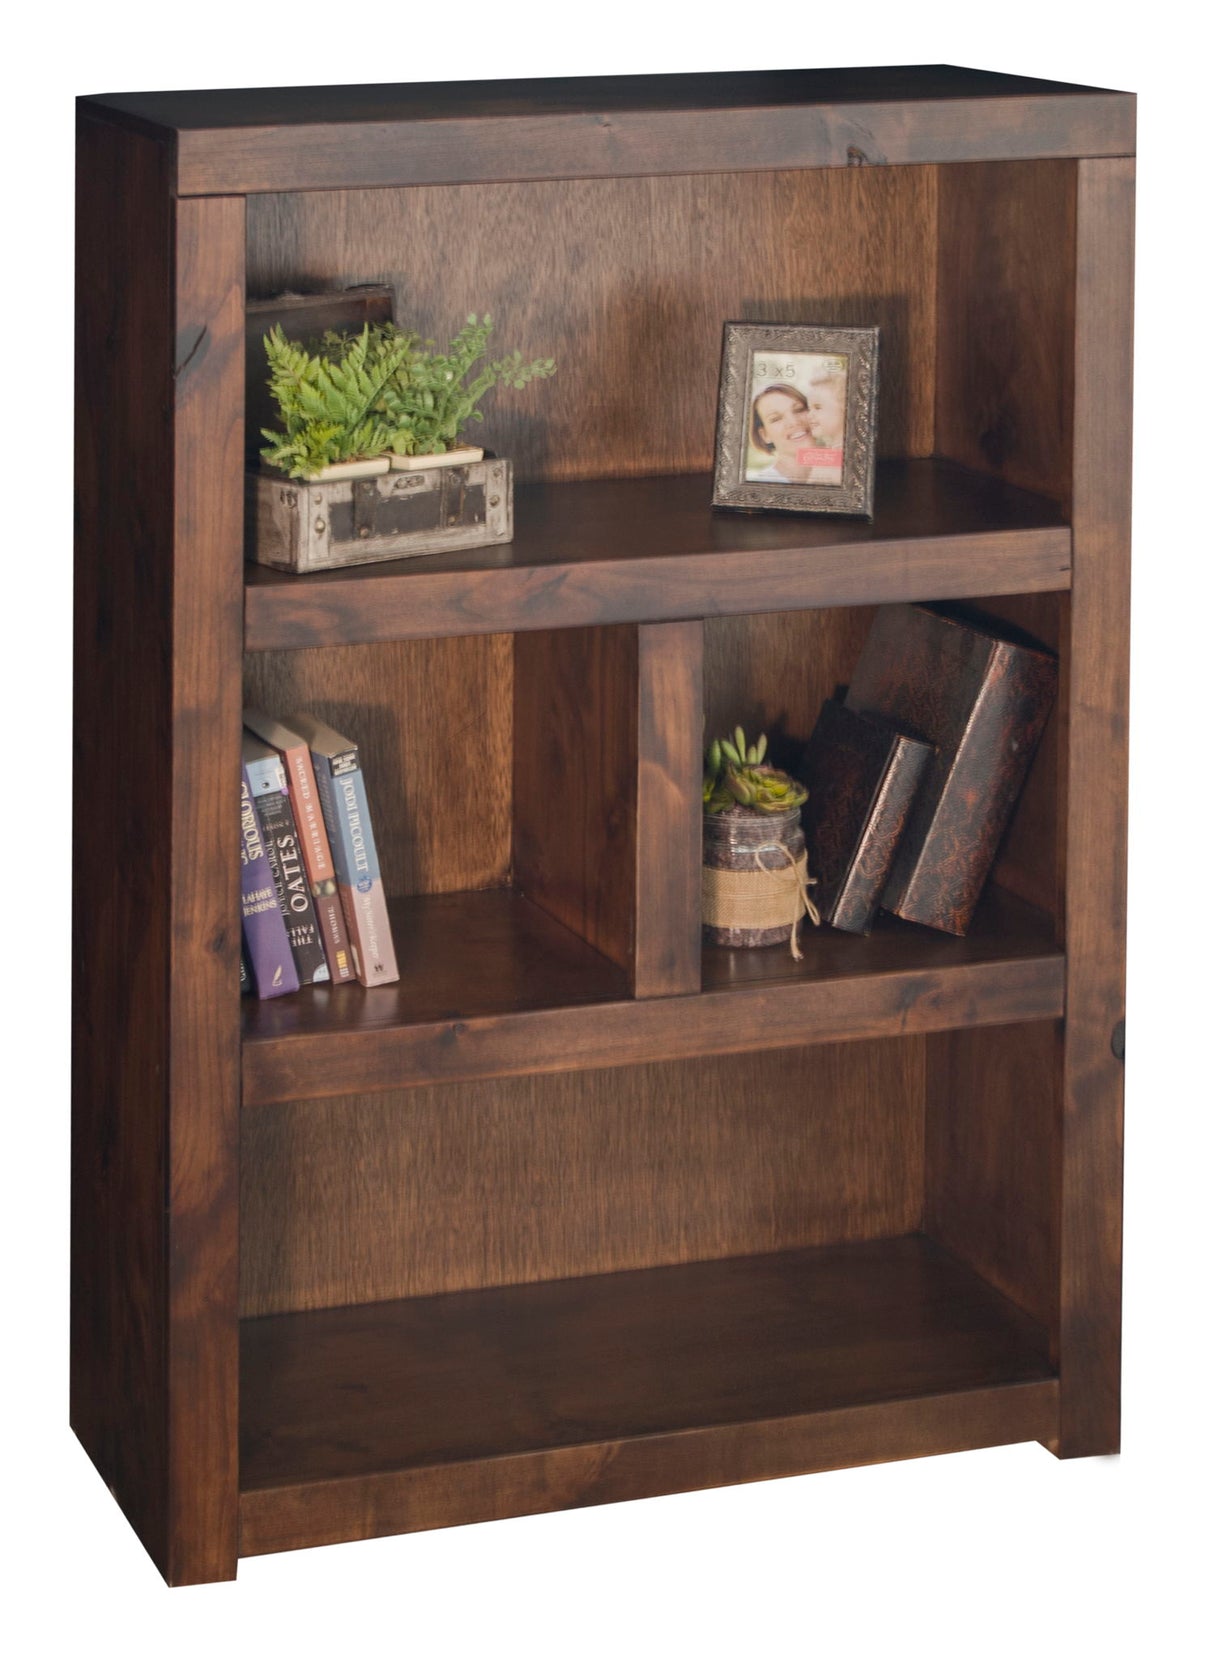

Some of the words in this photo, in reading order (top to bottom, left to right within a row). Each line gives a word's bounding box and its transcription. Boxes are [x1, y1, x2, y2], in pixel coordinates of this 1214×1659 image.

[756, 363, 767, 377] 3
[340, 778, 357, 811] JODI
[295, 757, 310, 799] SACRED
[305, 802, 326, 868] MARRIAGE
[348, 811, 369, 873] PICOULT
[277, 834, 309, 912] OATES
[242, 886, 273, 905] LAHAYE
[243, 899, 277, 917] JENKINS
[292, 934, 313, 947] THE
